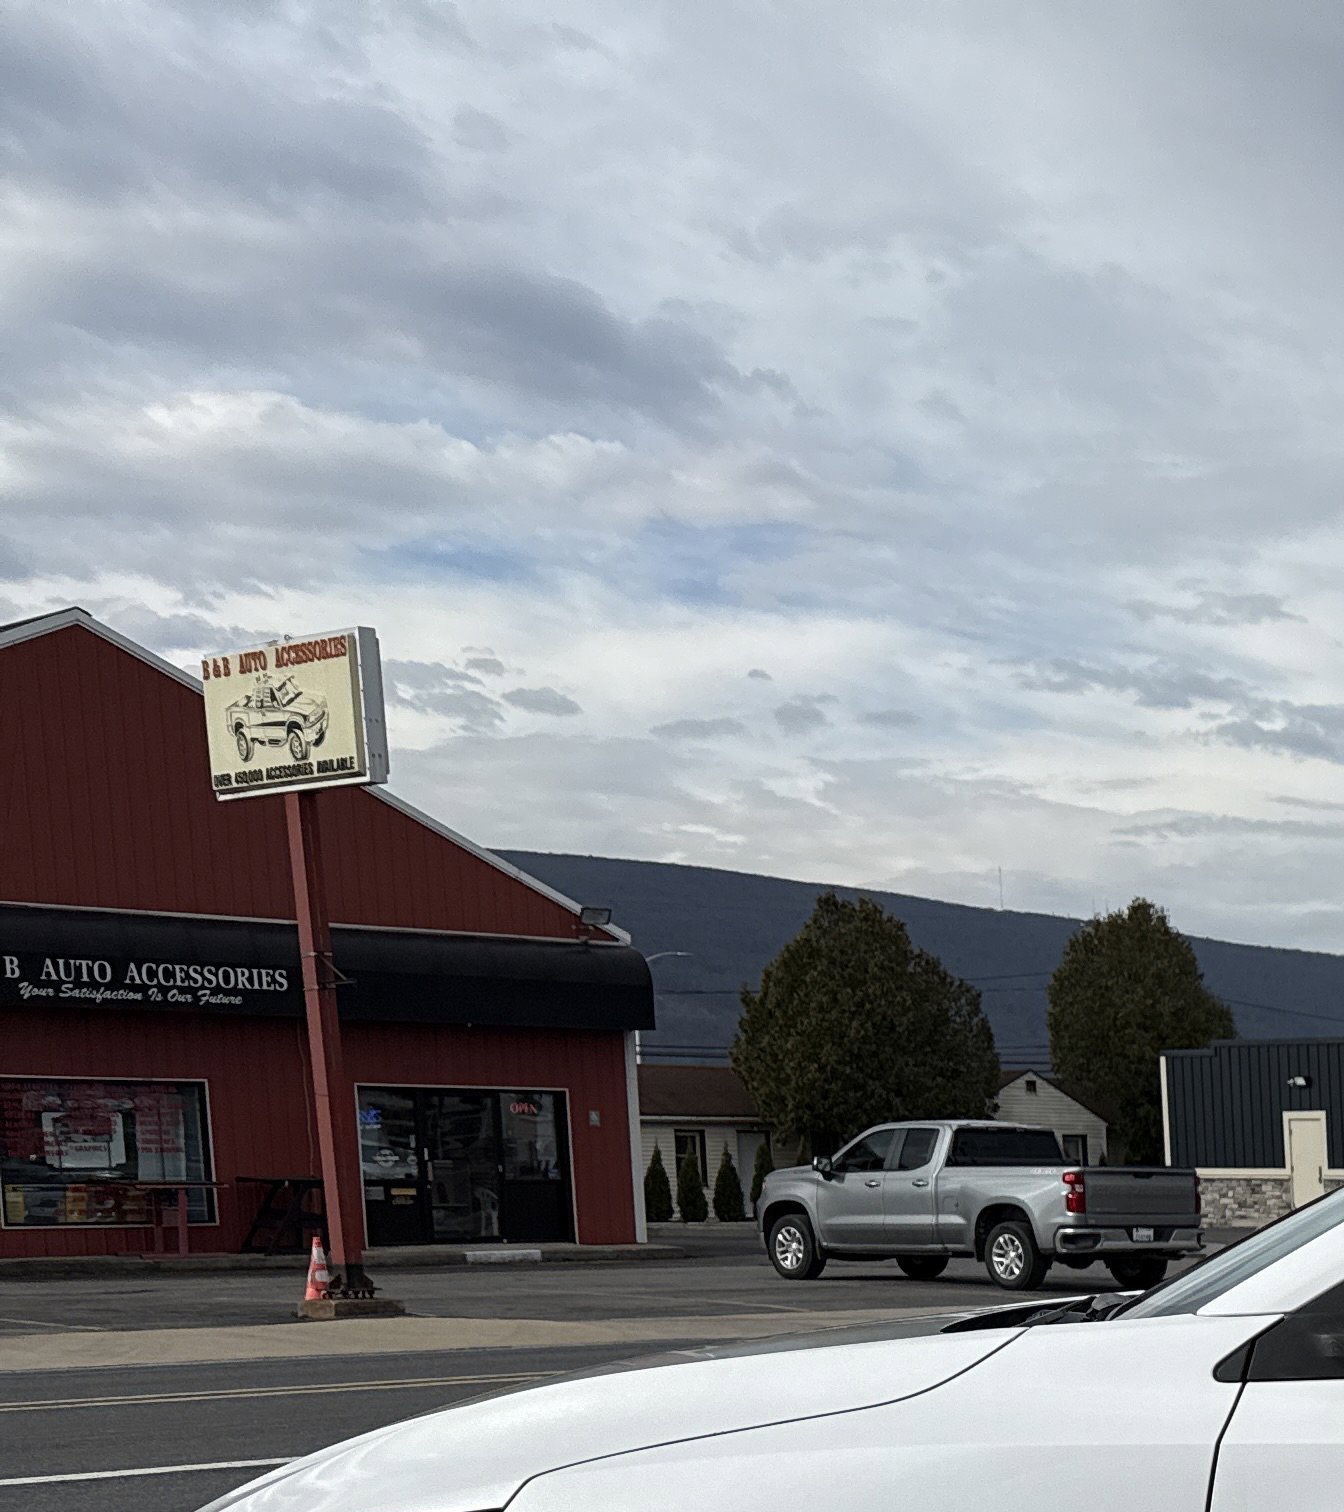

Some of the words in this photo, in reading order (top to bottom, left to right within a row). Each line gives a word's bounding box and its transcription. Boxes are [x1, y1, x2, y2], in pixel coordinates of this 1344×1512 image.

[239, 650, 268, 675] AUTO
[275, 635, 347, 669] ACCESSORIES
[214, 773, 232, 788] OVER
[266, 762, 314, 781] ACCESSORIES
[317, 756, 355, 774] AVAILABLE
[3, 955, 20, 978] B
[40, 958, 112, 983] AUTO
[124, 962, 289, 991] ACCESSORIES
[18, 981, 55, 999] Your
[58, 984, 143, 1003] Satisfaction
[149, 988, 163, 1001] Is
[167, 988, 193, 1003] Our
[197, 990, 243, 1006] Future
[509, 1102, 537, 1115] OPEN
